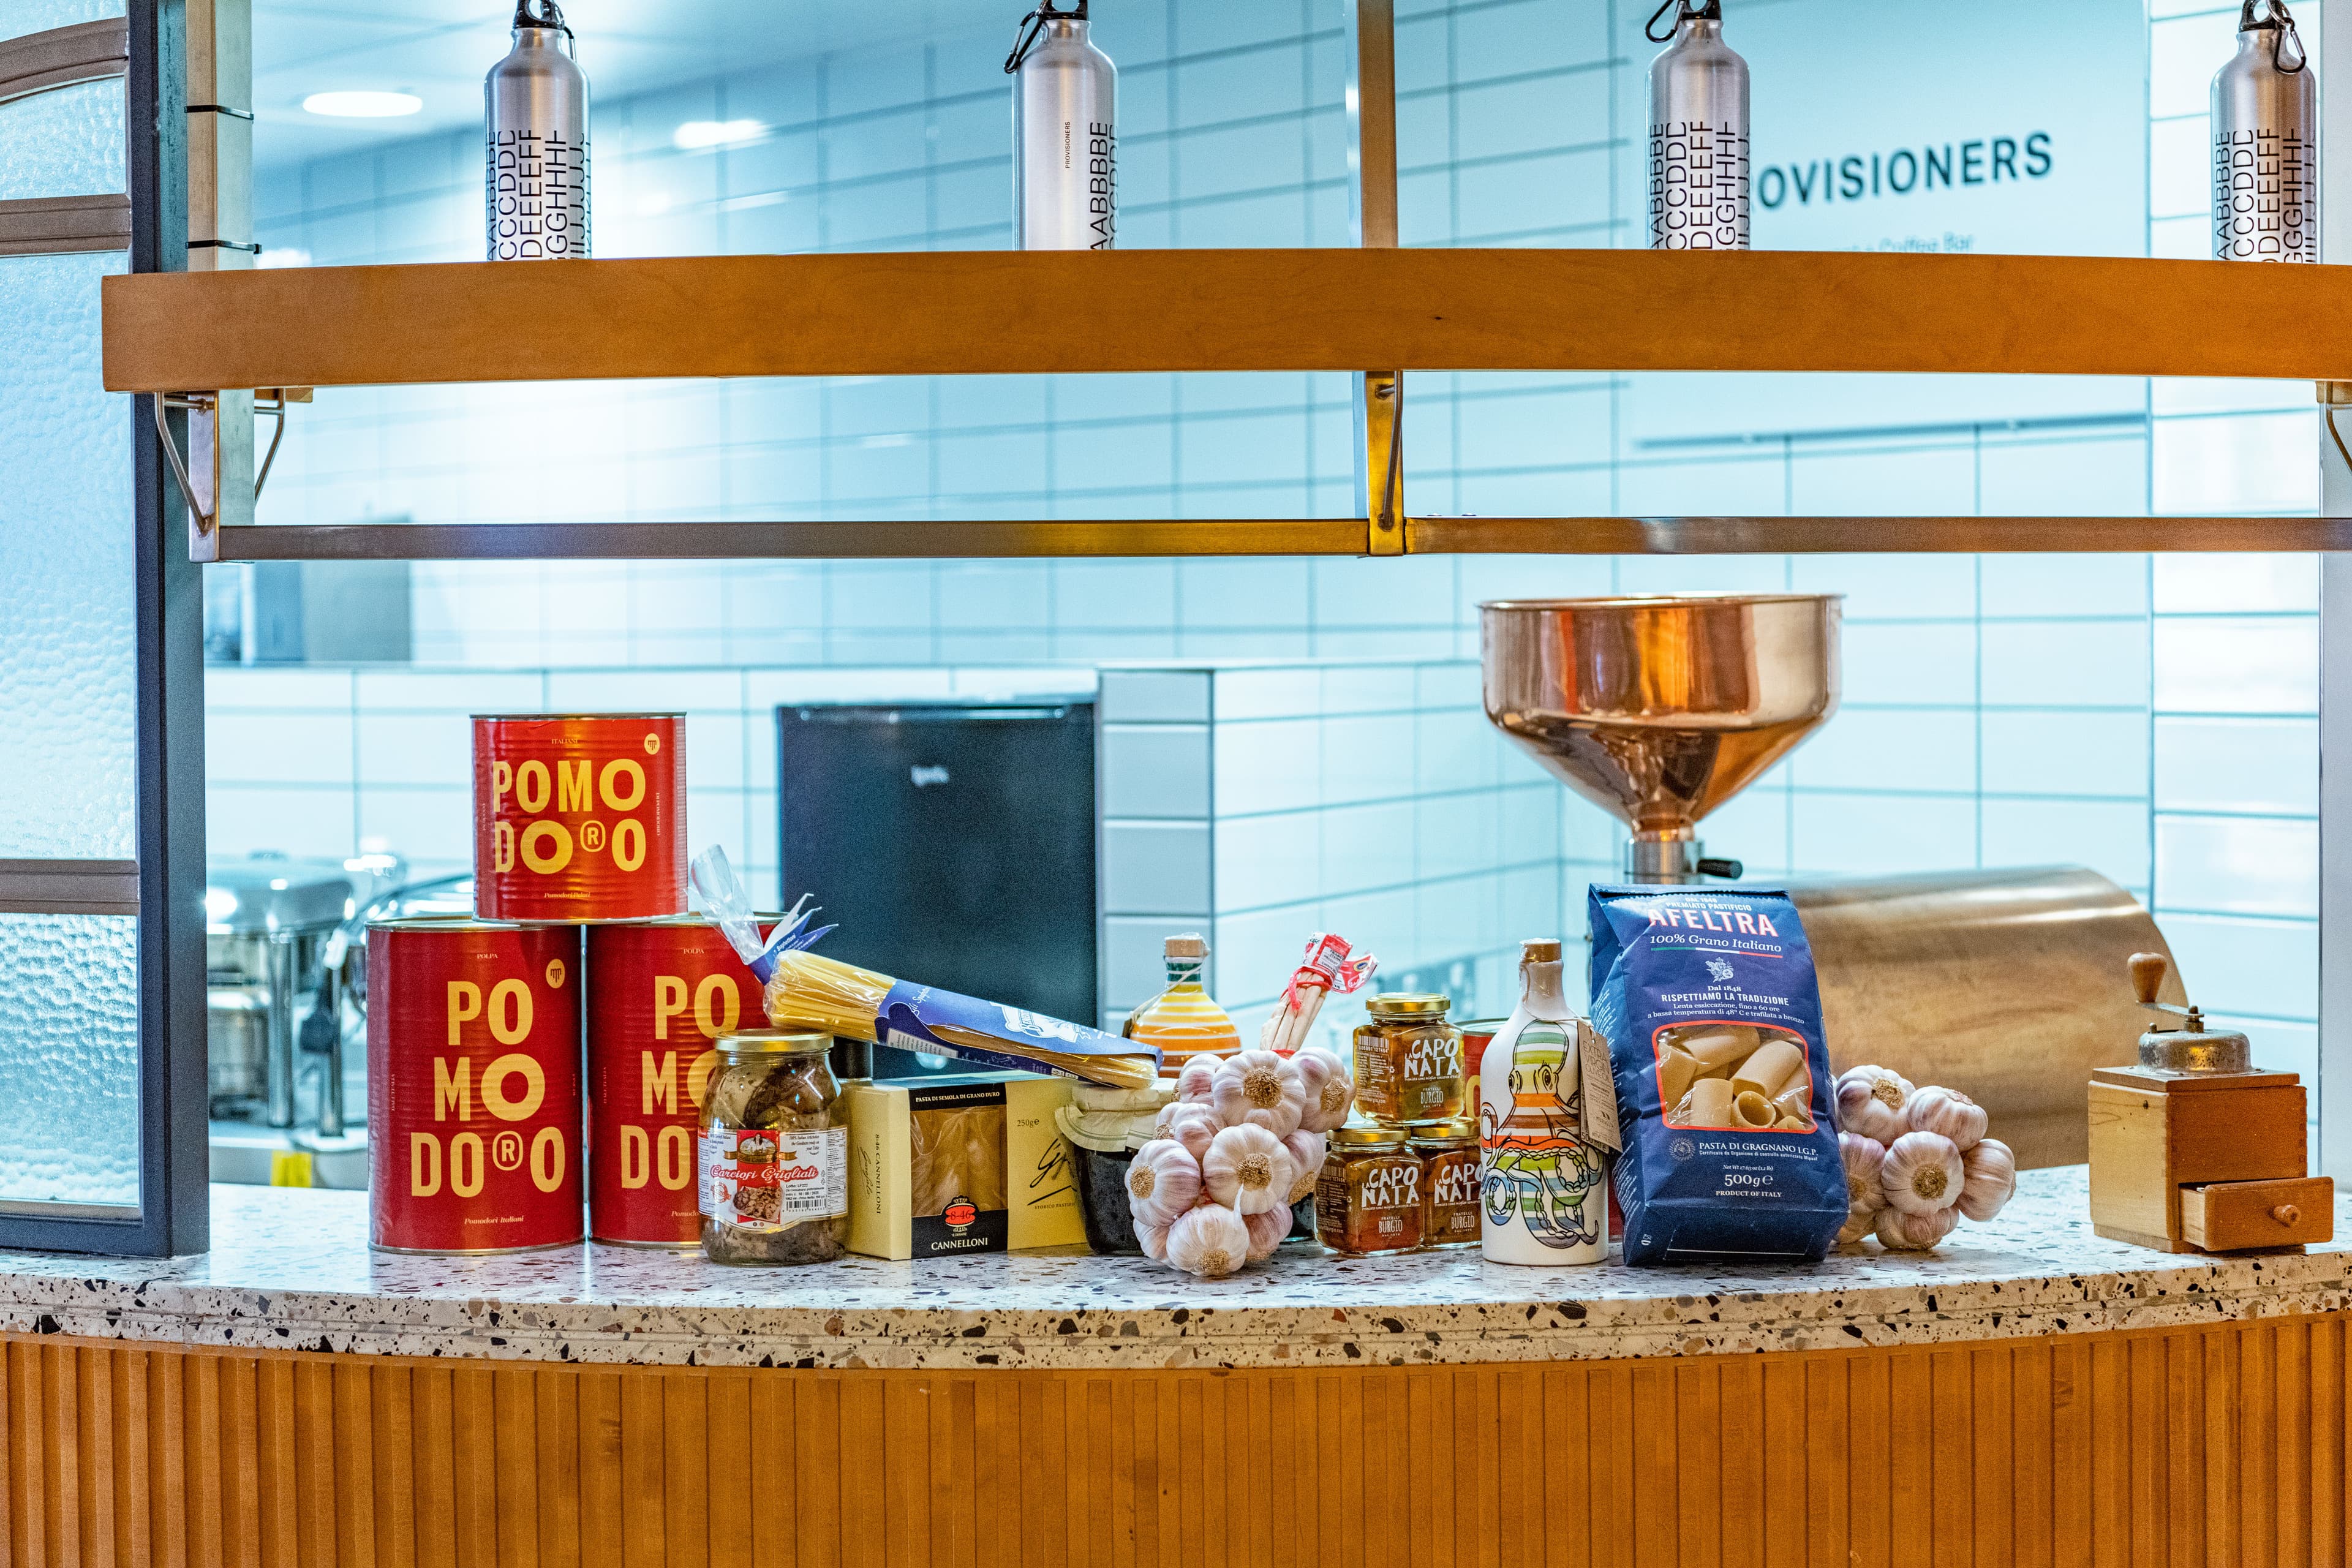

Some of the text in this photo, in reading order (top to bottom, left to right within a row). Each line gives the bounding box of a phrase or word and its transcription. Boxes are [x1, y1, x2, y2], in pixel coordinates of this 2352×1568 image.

[1752, 130, 2053, 211] OVISIONERS
[492, 758, 646, 813] POMO
[1648, 908, 1779, 937] AFELTRA
[1649, 933, 1782, 952] 100% Grano Italiano
[655, 974, 740, 1039] PO
[1661, 992, 1790, 1006] RISPETTIAMO LA TRADIZIONE
[448, 978, 533, 1045] PO
[1783, 1014, 1804, 1024] bronzo
[1411, 1038, 1460, 1060] CAPO
[1404, 1057, 1461, 1078] NATA
[434, 1053, 545, 1121] MO
[1420, 1091, 1444, 1104] BURGIO
[1742, 1143, 1796, 1152] GRAGNANO
[1798, 1146, 1819, 1156] I.G.P.
[710, 1165, 818, 1183] Carciofi Grigliati
[1368, 1166, 1419, 1189] CAPO
[1724, 1174, 1760, 1187] 500g
[1361, 1185, 1420, 1208] NATA
[1434, 1182, 1482, 1204] NAT
[950, 1210, 971, 1221] 8-46
[1451, 1215, 1475, 1229] BURGIO
[1379, 1220, 1403, 1234] BURGIO
[931, 1237, 988, 1250] CANNELLONI
